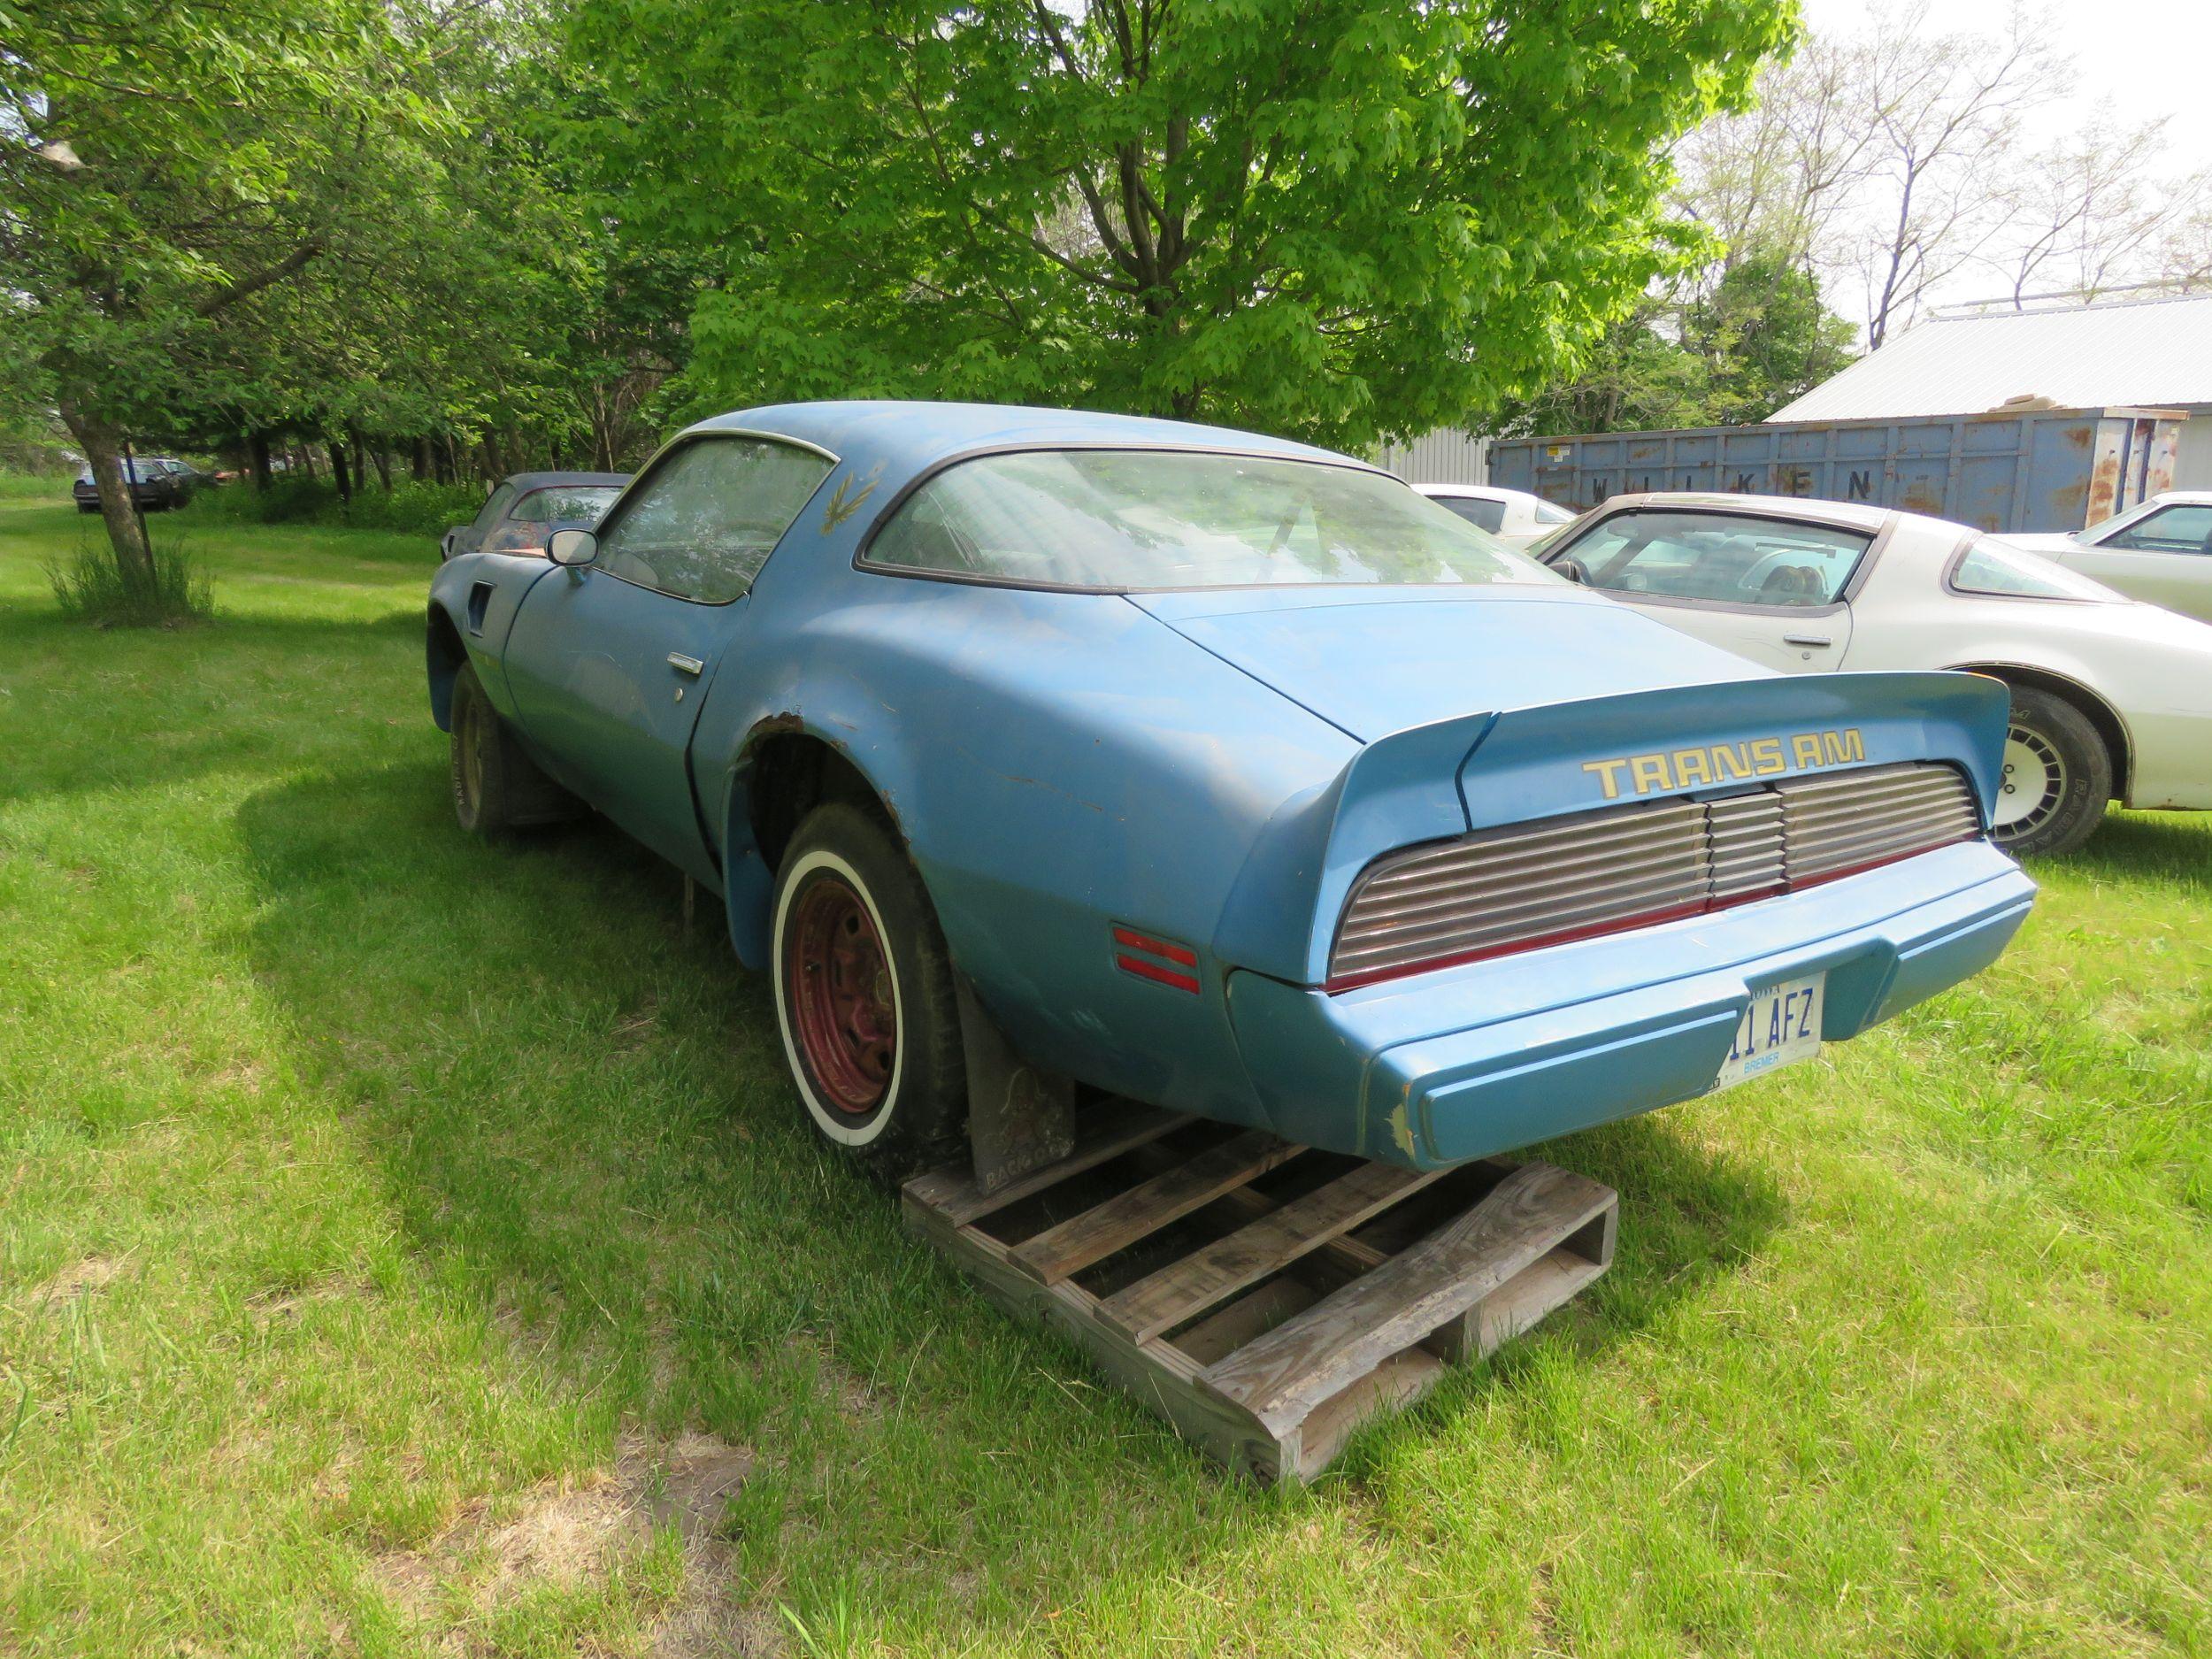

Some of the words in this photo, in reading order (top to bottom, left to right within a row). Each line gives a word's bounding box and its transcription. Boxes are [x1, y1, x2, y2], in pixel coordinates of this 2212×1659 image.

[1582, 736, 1786, 800] TRANS
[1791, 727, 1865, 771] AM
[1768, 988, 1813, 1048] AFZ
[1744, 1051, 1779, 1074] BREMER
